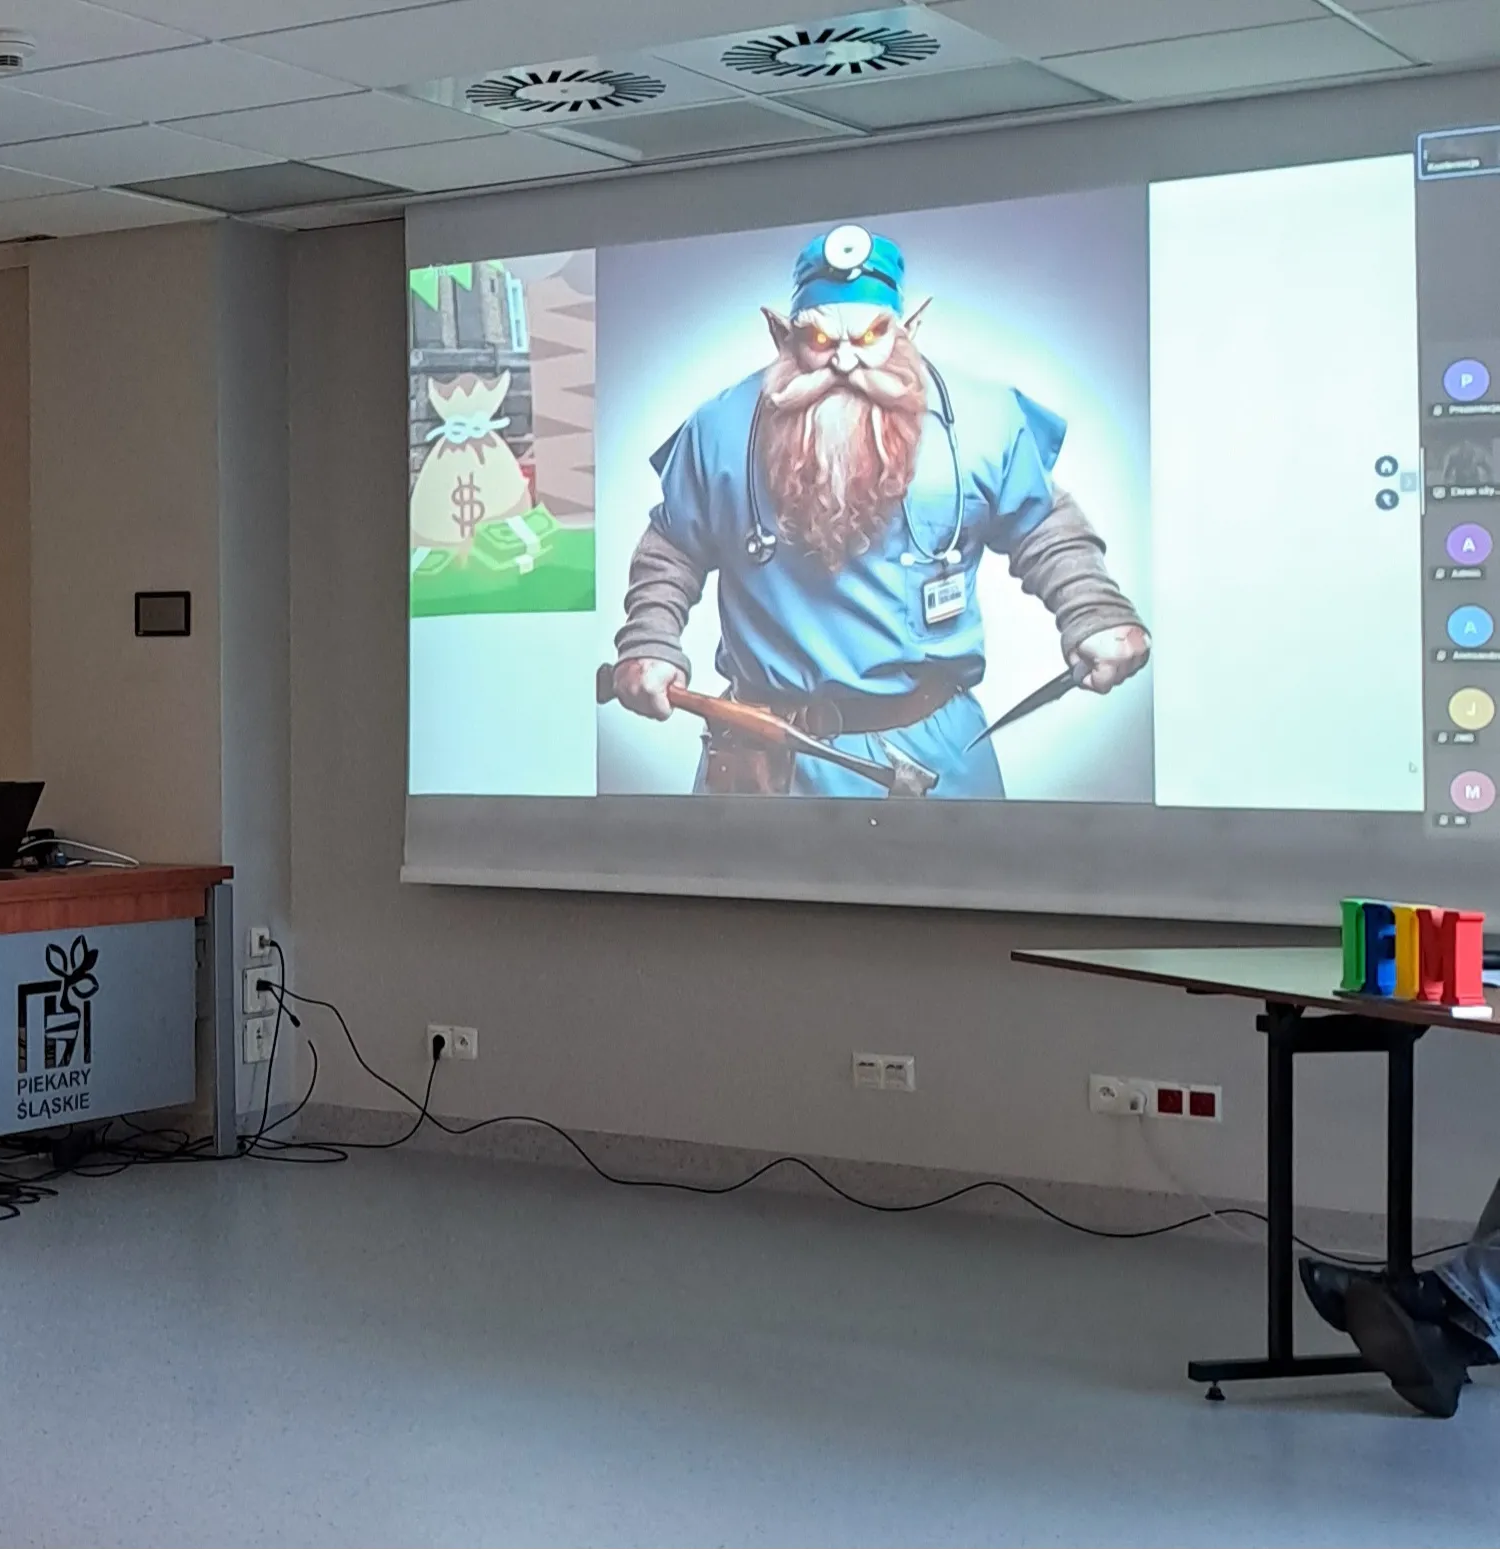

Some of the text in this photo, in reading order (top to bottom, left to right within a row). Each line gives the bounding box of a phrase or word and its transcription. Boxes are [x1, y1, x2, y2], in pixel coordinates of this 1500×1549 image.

[1461, 373, 1473, 389] P
[1462, 537, 1476, 553] A
[1464, 620, 1478, 635] A
[1465, 785, 1480, 799] M
[17, 1069, 90, 1096] PIEKARY
[17, 1093, 90, 1120] ŚLĄSKIE
